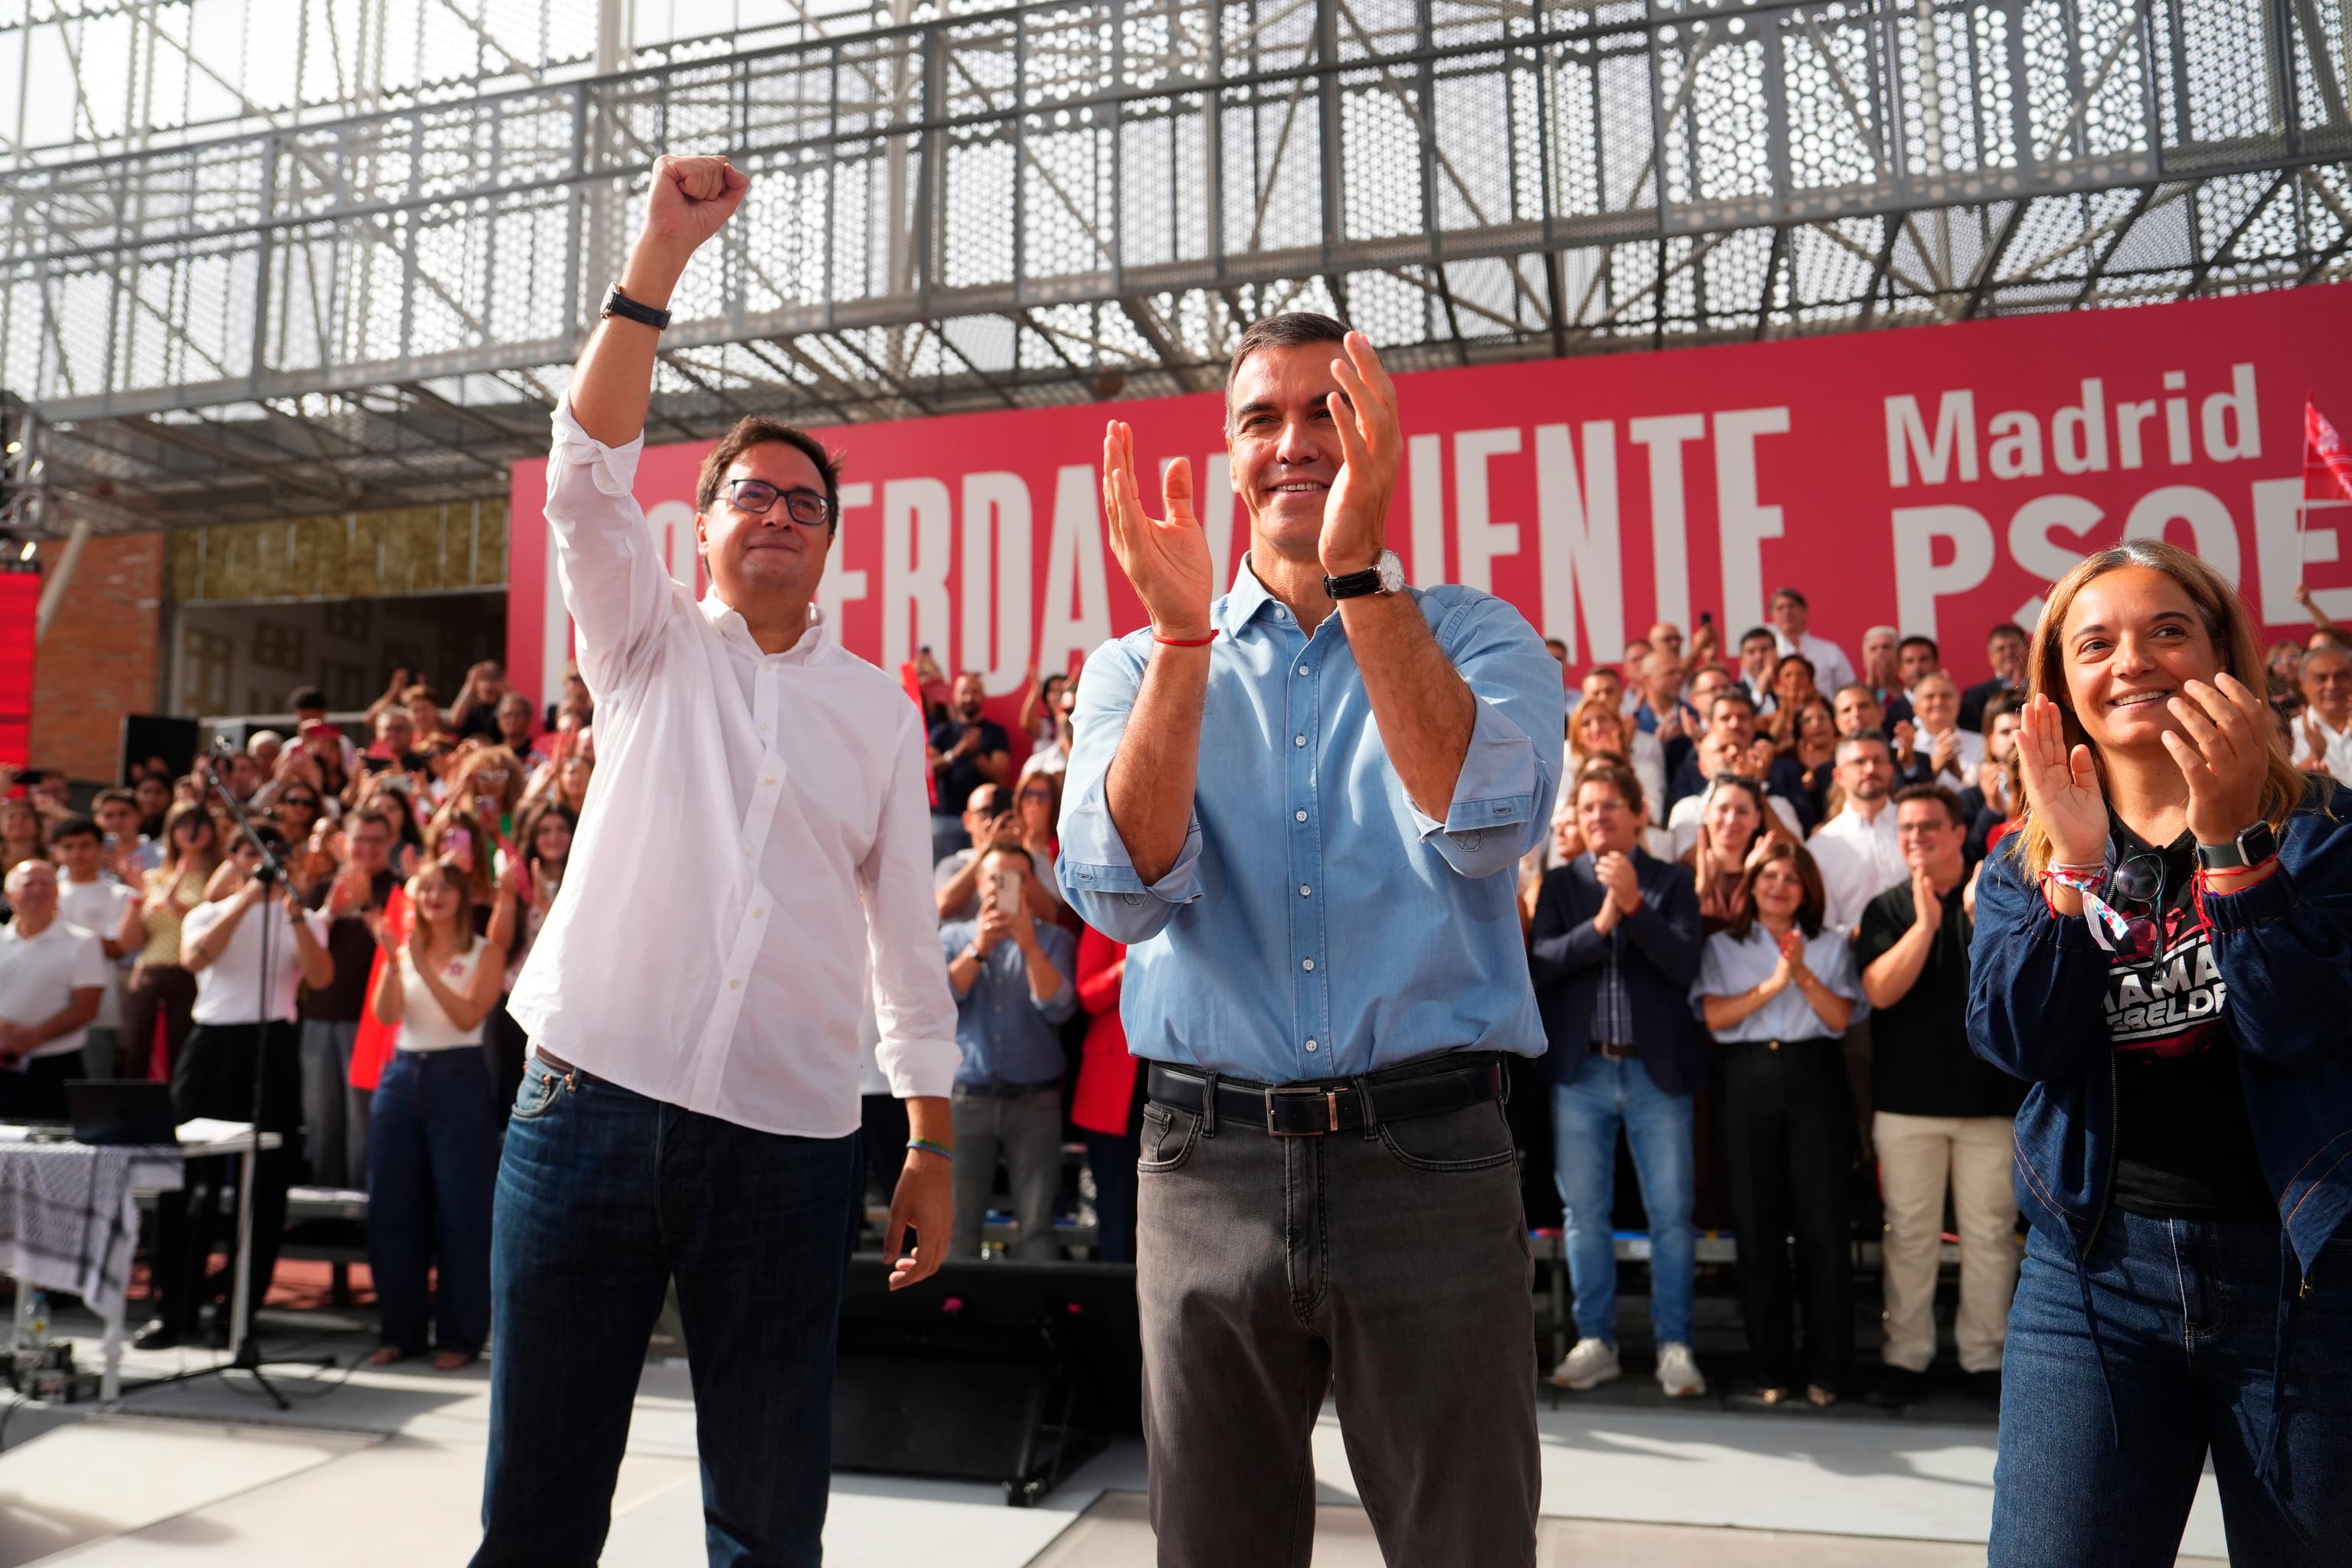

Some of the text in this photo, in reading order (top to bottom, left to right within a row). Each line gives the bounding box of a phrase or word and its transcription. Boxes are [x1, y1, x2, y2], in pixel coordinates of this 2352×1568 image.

[1884, 362, 2262, 488] Madrid
[2101, 944, 2223, 1014] AMA
[2106, 982, 2226, 1031] EBELD
